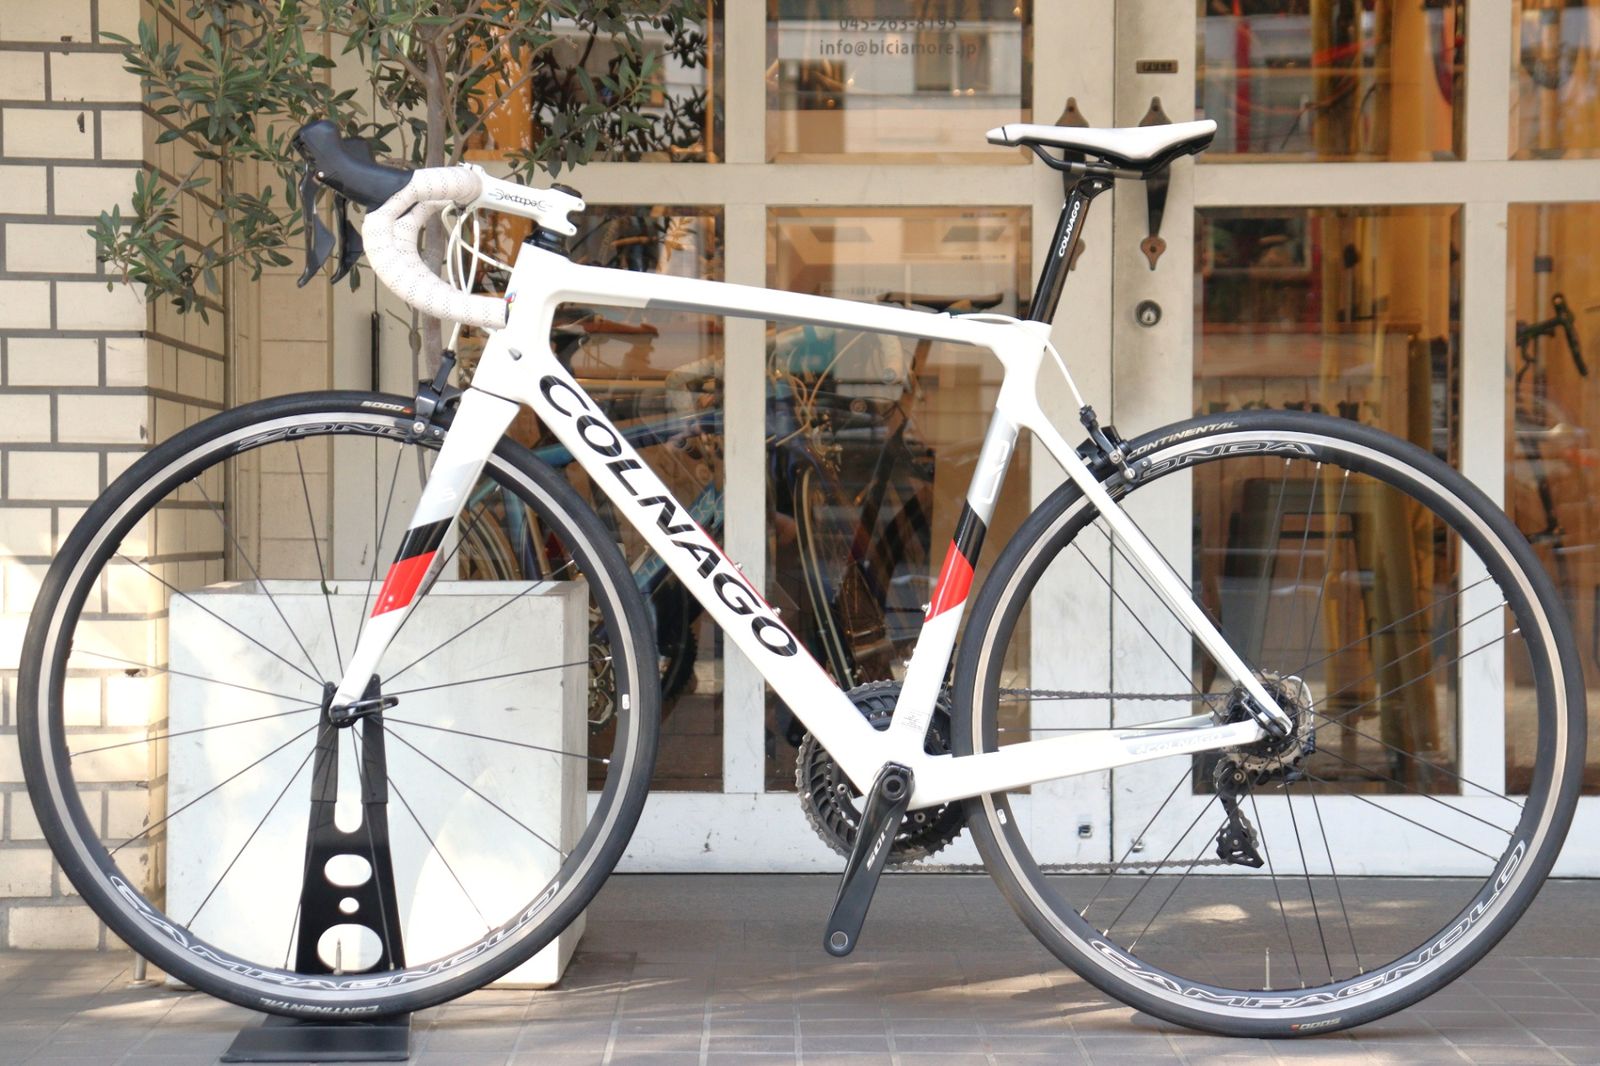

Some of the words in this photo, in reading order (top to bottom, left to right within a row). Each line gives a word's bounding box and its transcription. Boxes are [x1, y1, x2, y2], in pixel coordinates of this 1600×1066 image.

[820, 39, 977, 57] info@biciamore.jp
[1059, 201, 1080, 257] COLNAGO
[1127, 421, 1239, 460] CONTINENTAL
[539, 375, 798, 657] COLNAGO
[110, 876, 560, 990] CAMPAGNOLO
[1090, 839, 1526, 1009] CAMPAGNOLO
[260, 997, 380, 1016] CONTINENTAL
